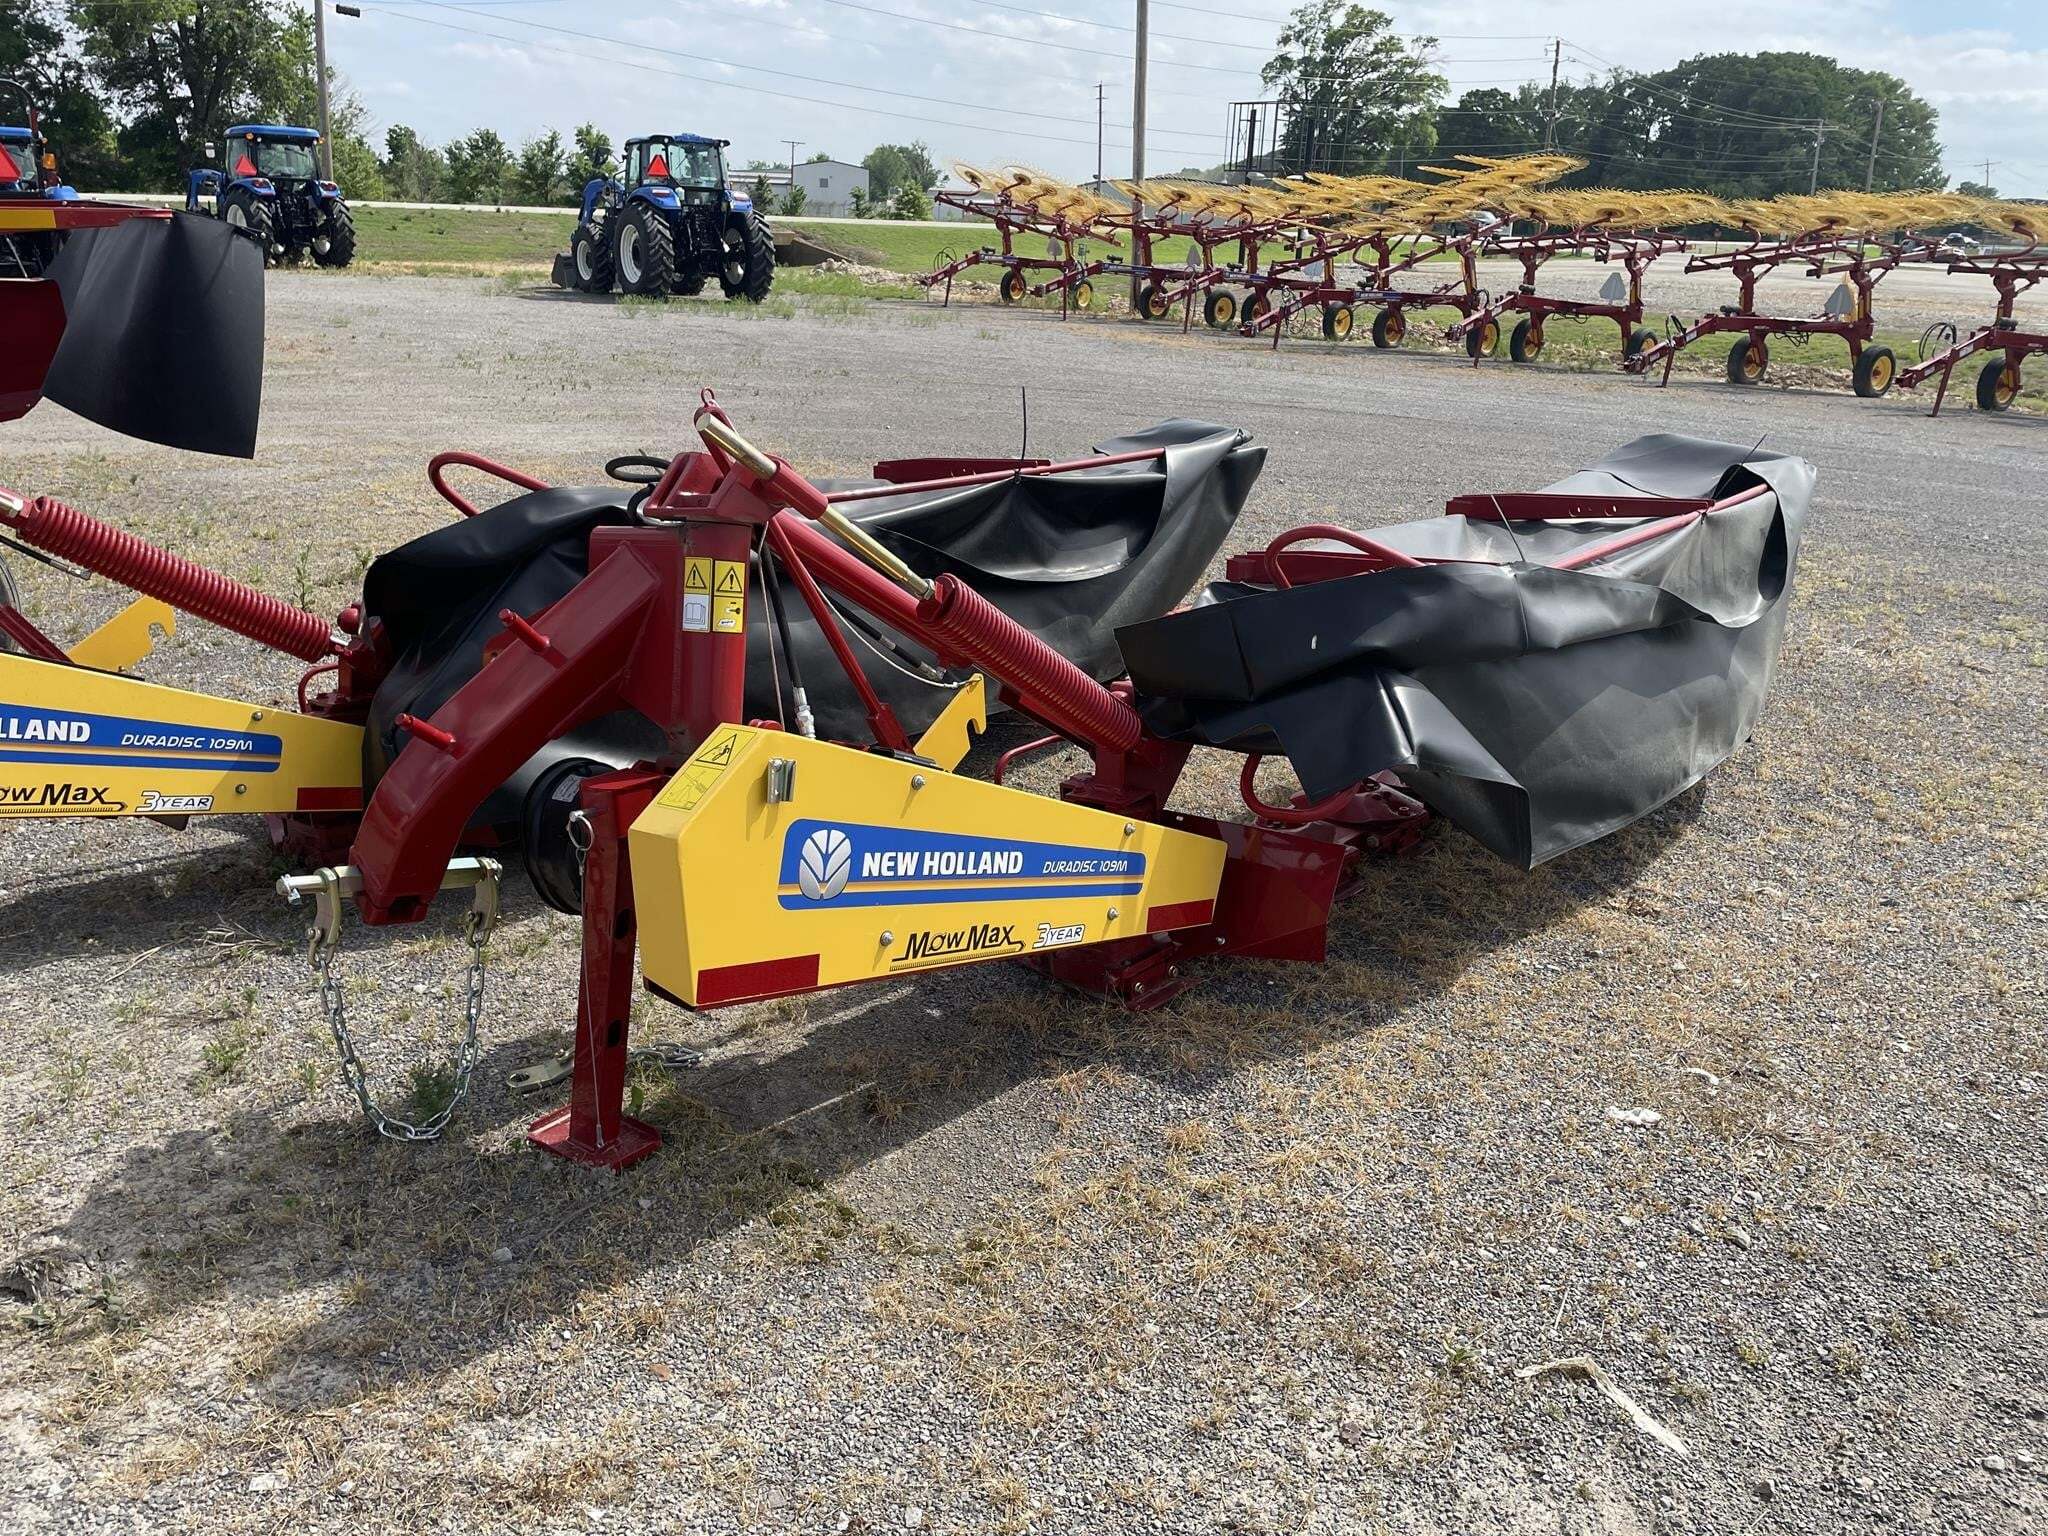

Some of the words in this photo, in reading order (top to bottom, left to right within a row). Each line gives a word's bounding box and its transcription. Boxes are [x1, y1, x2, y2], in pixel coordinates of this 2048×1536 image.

[121, 733, 206, 749] DURADISC
[209, 737, 253, 751] 109M
[161, 797, 210, 808] YEAR
[862, 851, 920, 877] NEW
[922, 850, 1023, 876] HOLLAND
[1042, 860, 1097, 874] DURADISC
[1099, 859, 1128, 873] 109M
[1050, 926, 1083, 942] YEAR
